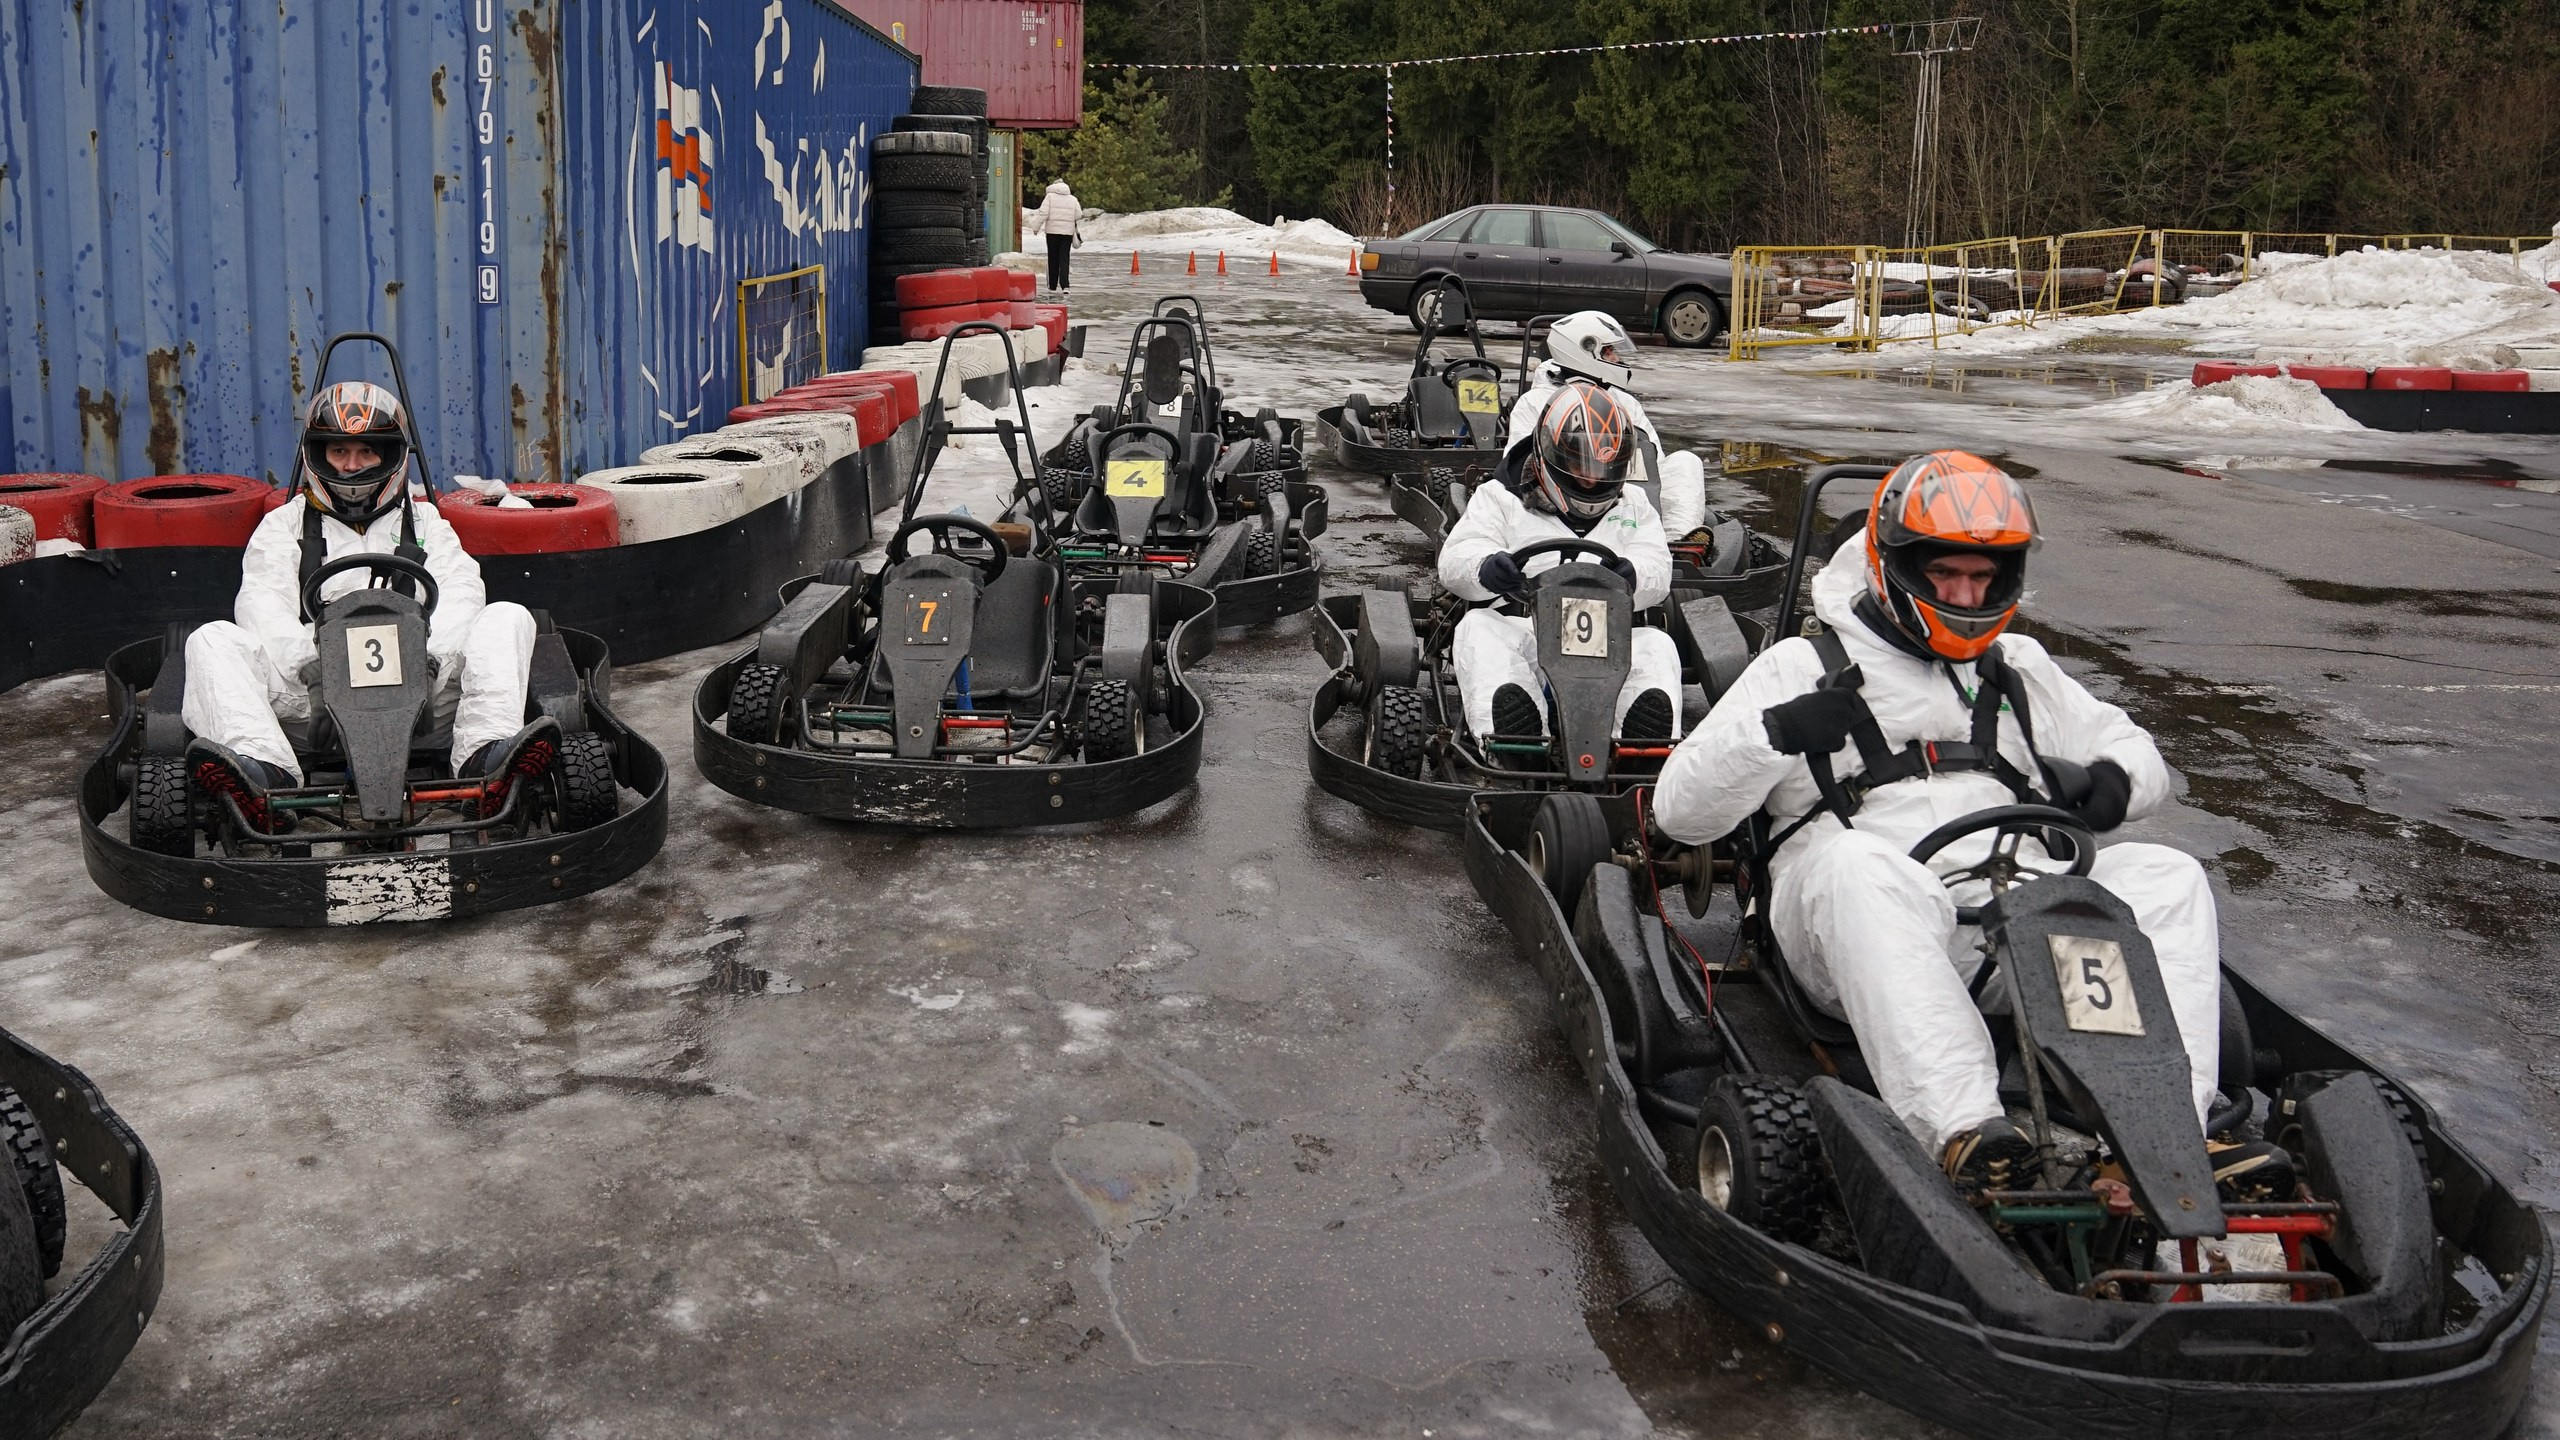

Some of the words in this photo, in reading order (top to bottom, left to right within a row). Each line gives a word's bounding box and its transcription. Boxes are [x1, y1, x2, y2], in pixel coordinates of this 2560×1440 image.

[476, 0, 492, 33] U
[477, 44, 494, 144] 679
[481, 156, 495, 254] 119
[481, 269, 496, 300] 9
[1465, 388, 1492, 405] 14
[1123, 470, 1147, 487] 4
[920, 601, 937, 633] 7
[1577, 611, 1592, 643] 9
[365, 638, 384, 672] 3
[2082, 957, 2112, 1010] 5
